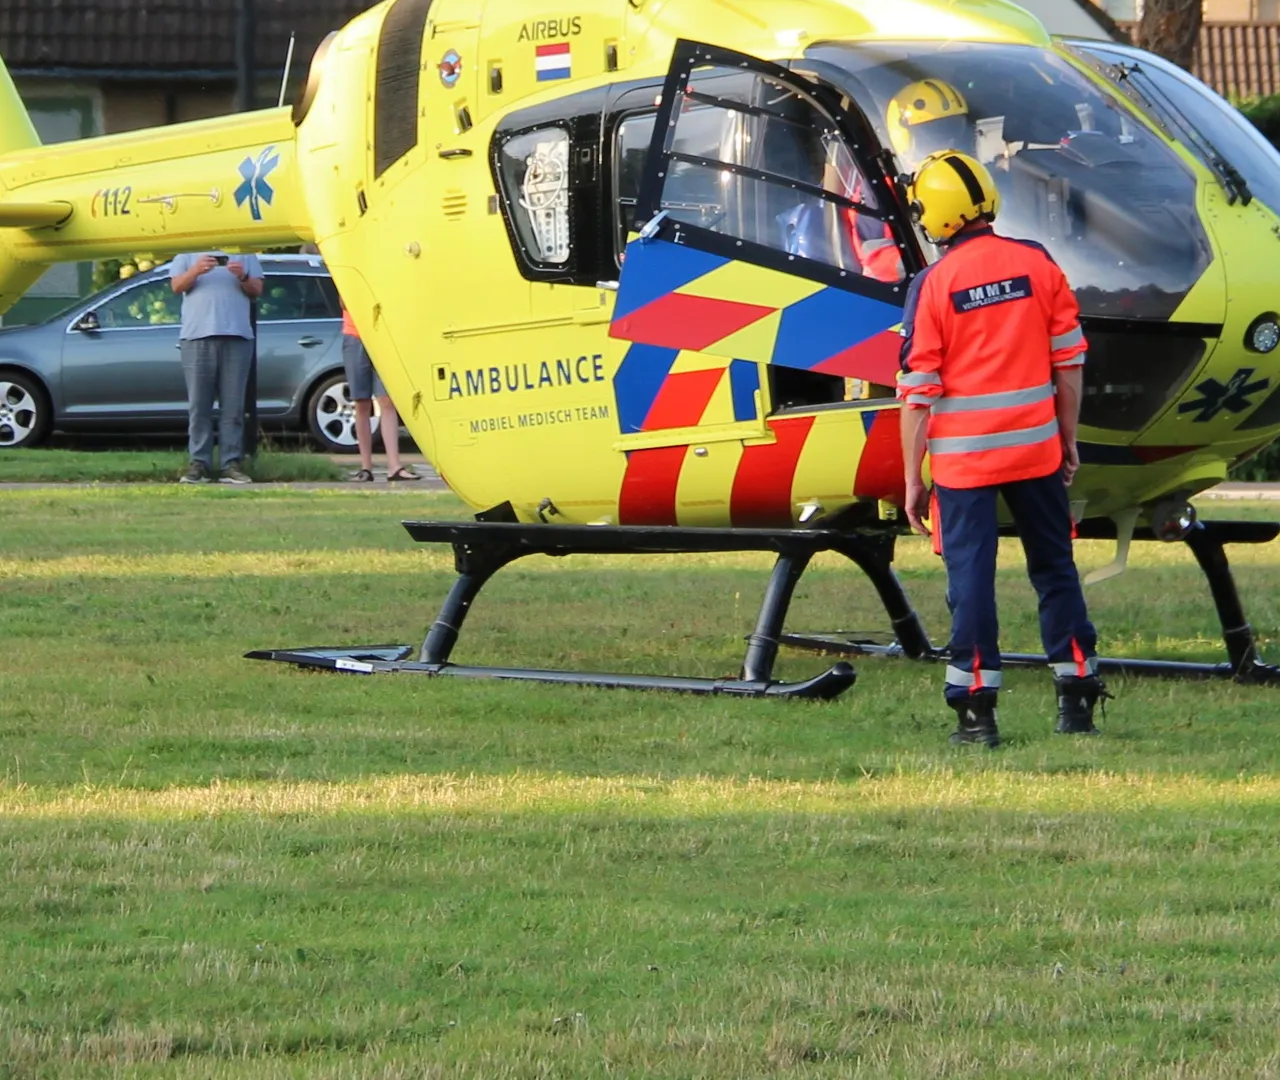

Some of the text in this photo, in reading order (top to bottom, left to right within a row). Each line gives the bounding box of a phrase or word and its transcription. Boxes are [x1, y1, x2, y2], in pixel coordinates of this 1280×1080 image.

[517, 16, 582, 42] AIRBUS
[968, 280, 1012, 301] MMT
[448, 354, 605, 400] AMBULANCE
[470, 405, 609, 433] MOBIEL MEDISCH TEAM
